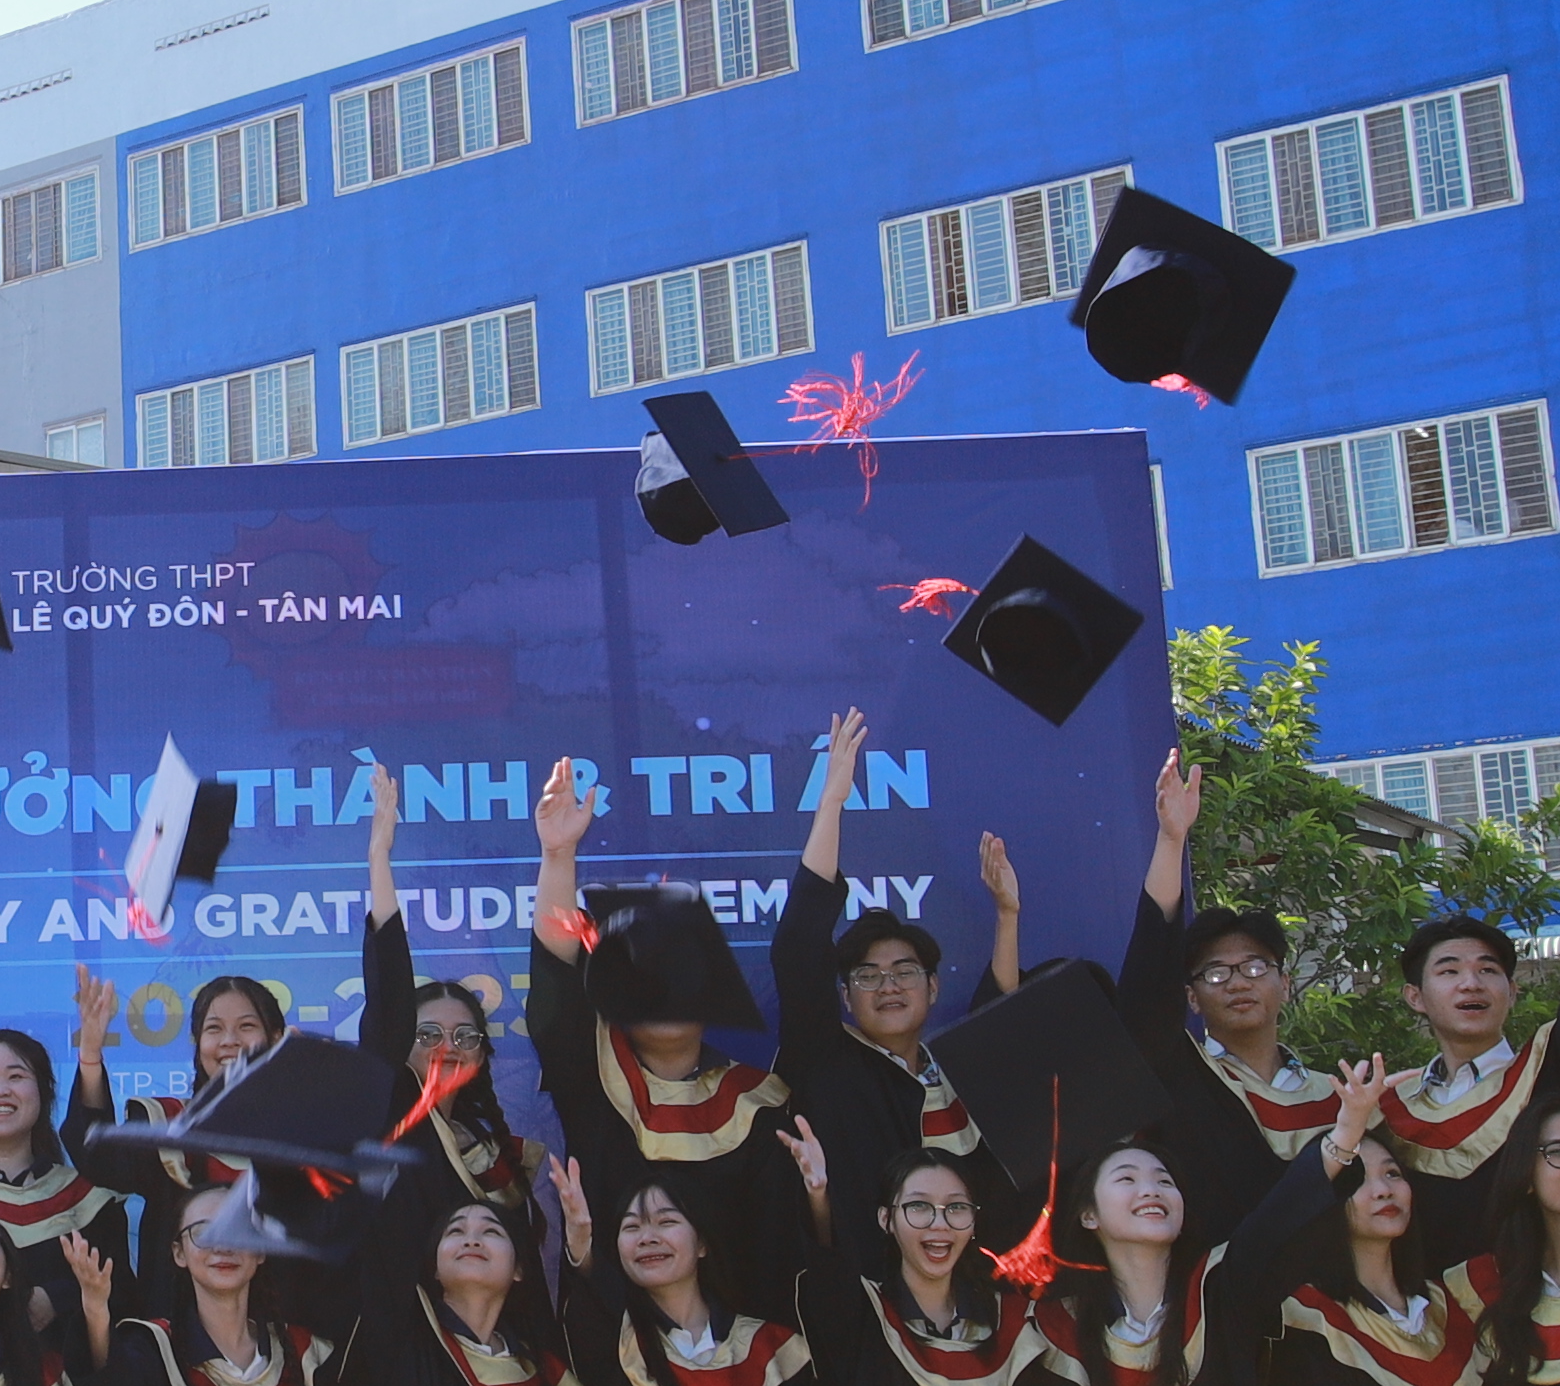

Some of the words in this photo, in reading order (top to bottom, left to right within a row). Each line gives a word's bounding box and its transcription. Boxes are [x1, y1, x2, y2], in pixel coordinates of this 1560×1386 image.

[12, 562, 158, 595] TRƯỜNG
[169, 562, 256, 589] THPT
[12, 601, 53, 632] LÊ
[63, 597, 137, 630] QUÝ
[148, 596, 225, 628] ĐÔN
[259, 592, 327, 623] TÂN
[340, 594, 401, 620] MAI
[631, 753, 774, 815] TRI
[112, 1071, 156, 1095] TP.
